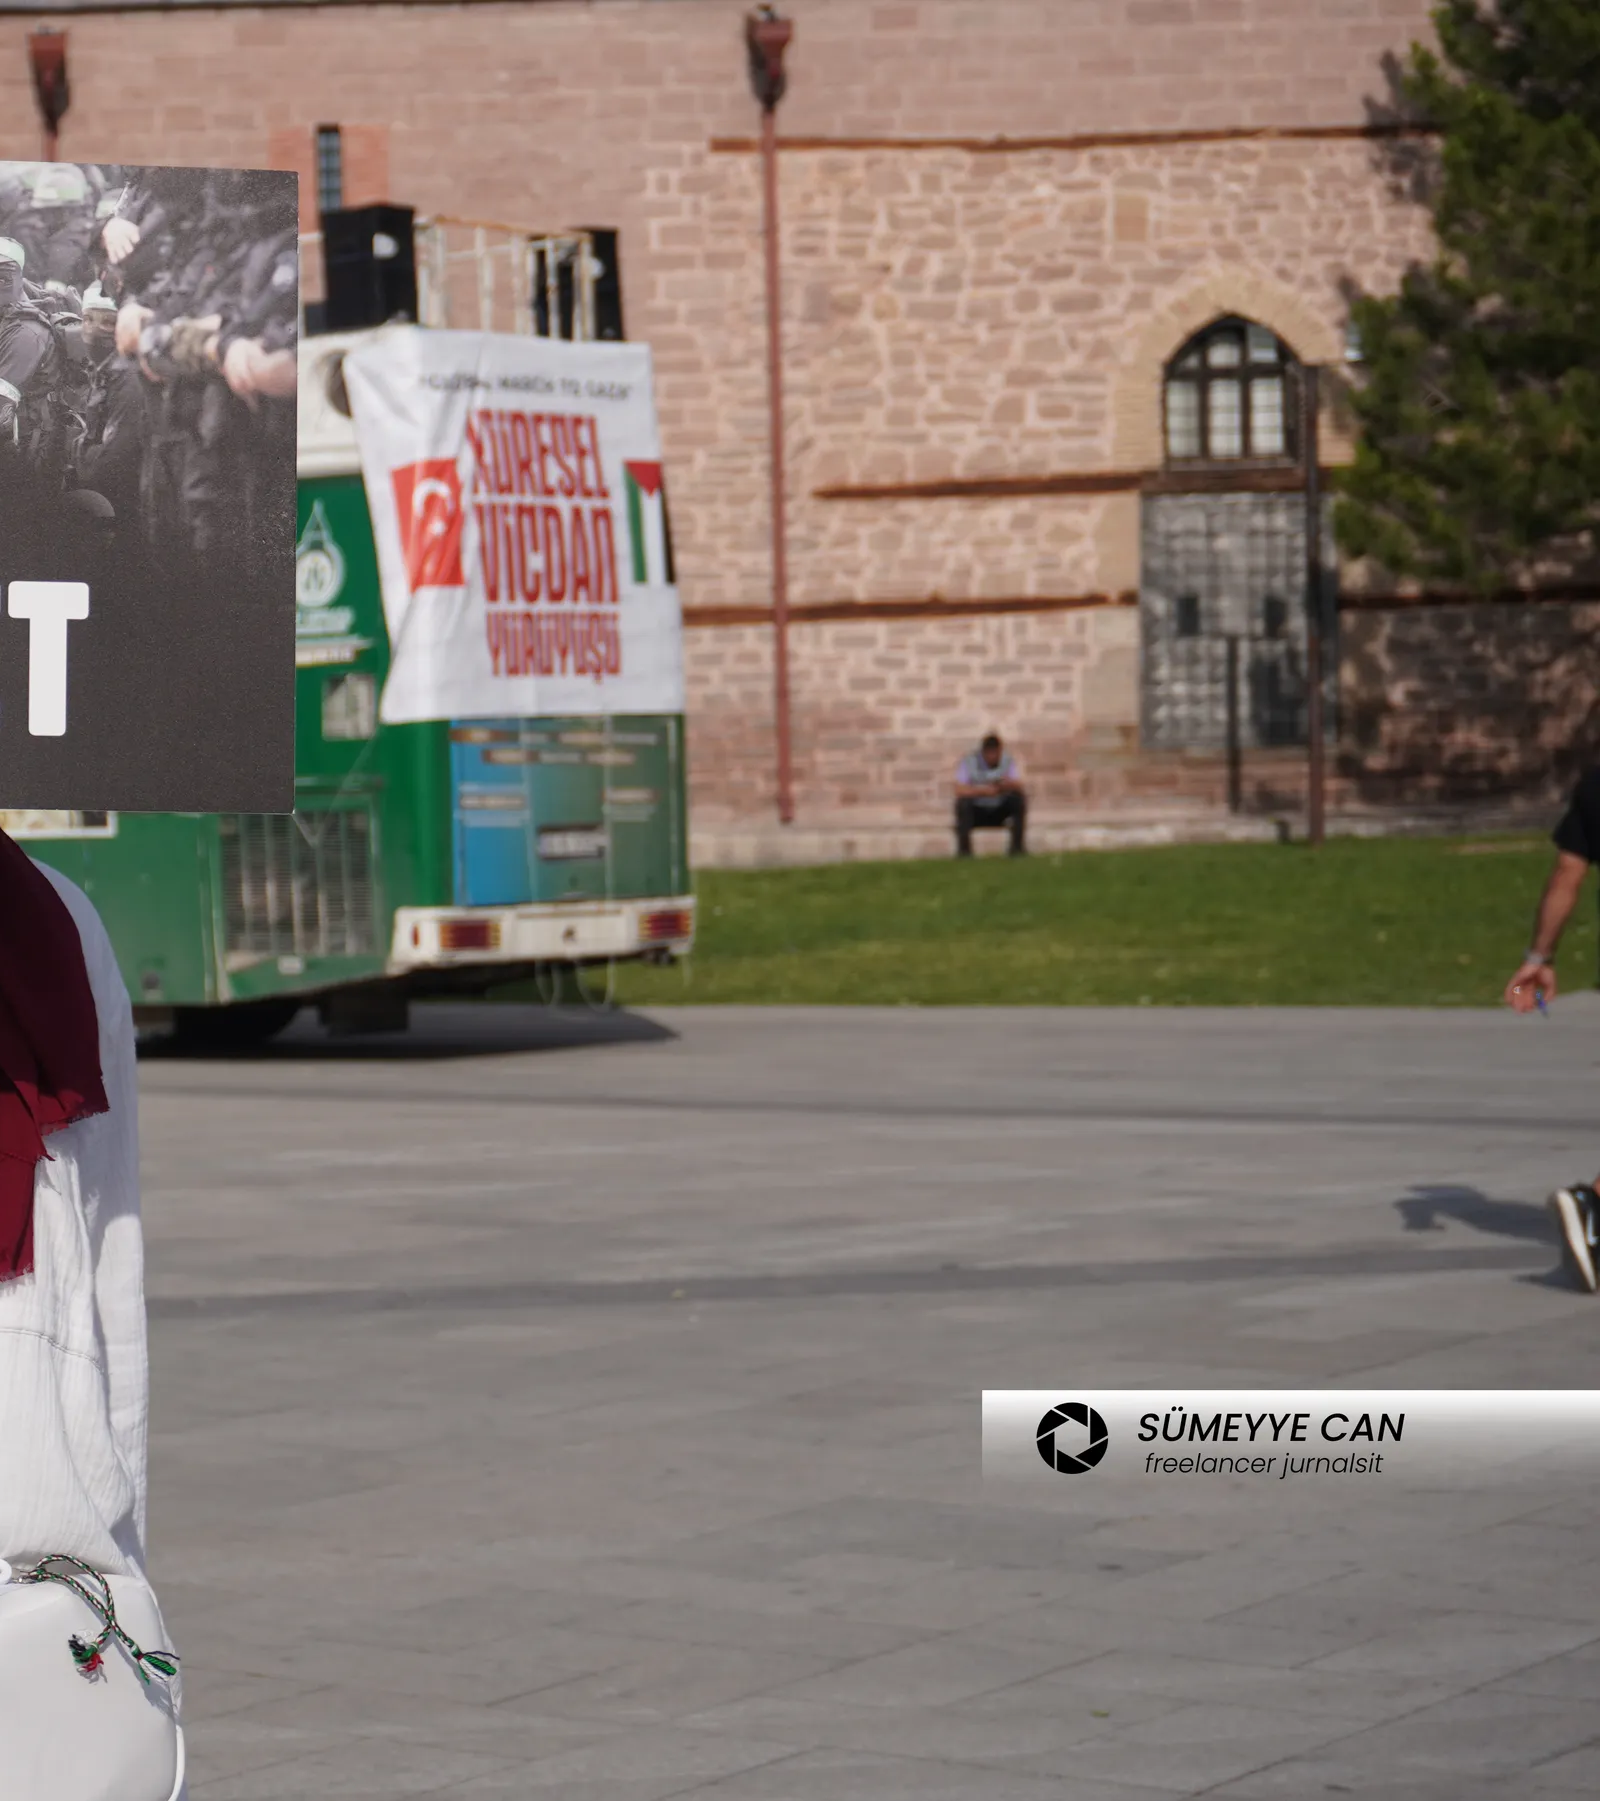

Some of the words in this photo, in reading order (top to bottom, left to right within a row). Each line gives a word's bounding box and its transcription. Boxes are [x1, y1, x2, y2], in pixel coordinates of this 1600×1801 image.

[467, 409, 609, 499] KÜRESEL
[473, 503, 620, 604] VİCDAN
[486, 610, 621, 686] YÜRÜYÜŞÜ
